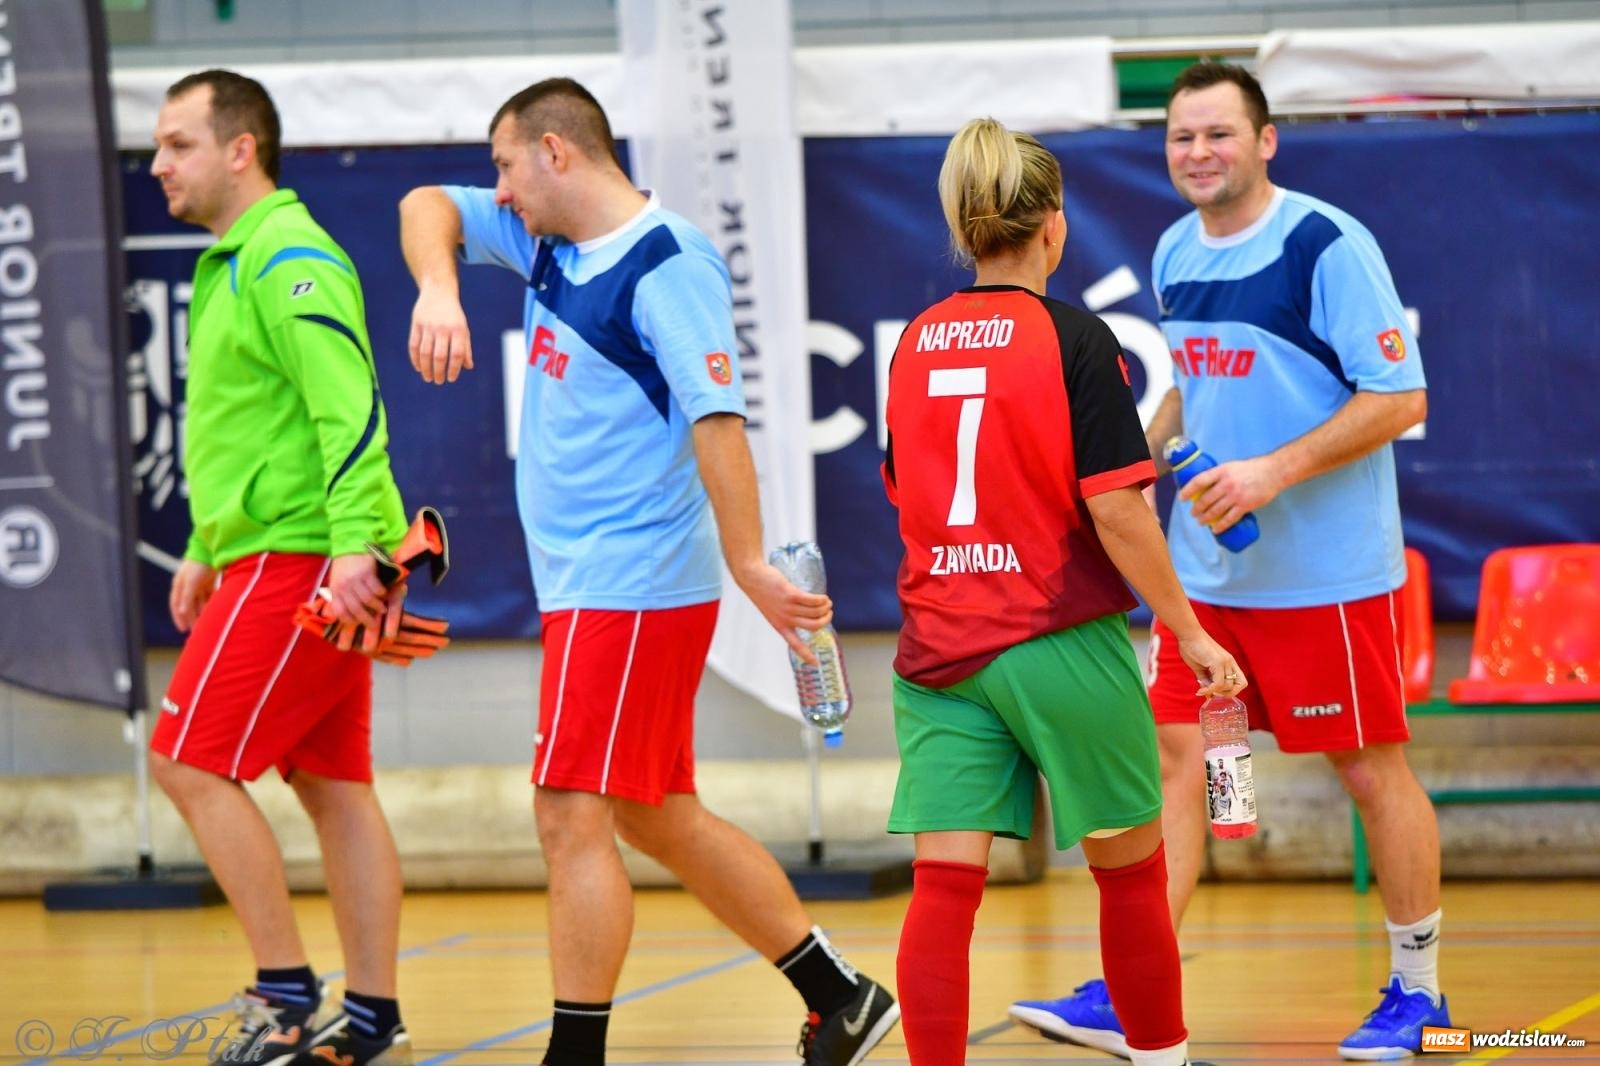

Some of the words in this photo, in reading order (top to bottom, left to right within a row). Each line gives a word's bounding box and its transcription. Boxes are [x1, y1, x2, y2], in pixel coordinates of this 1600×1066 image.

[916, 313, 1014, 353] NAPRZÓD
[927, 366, 987, 526] 7
[929, 543, 1022, 575] ZAWADA
